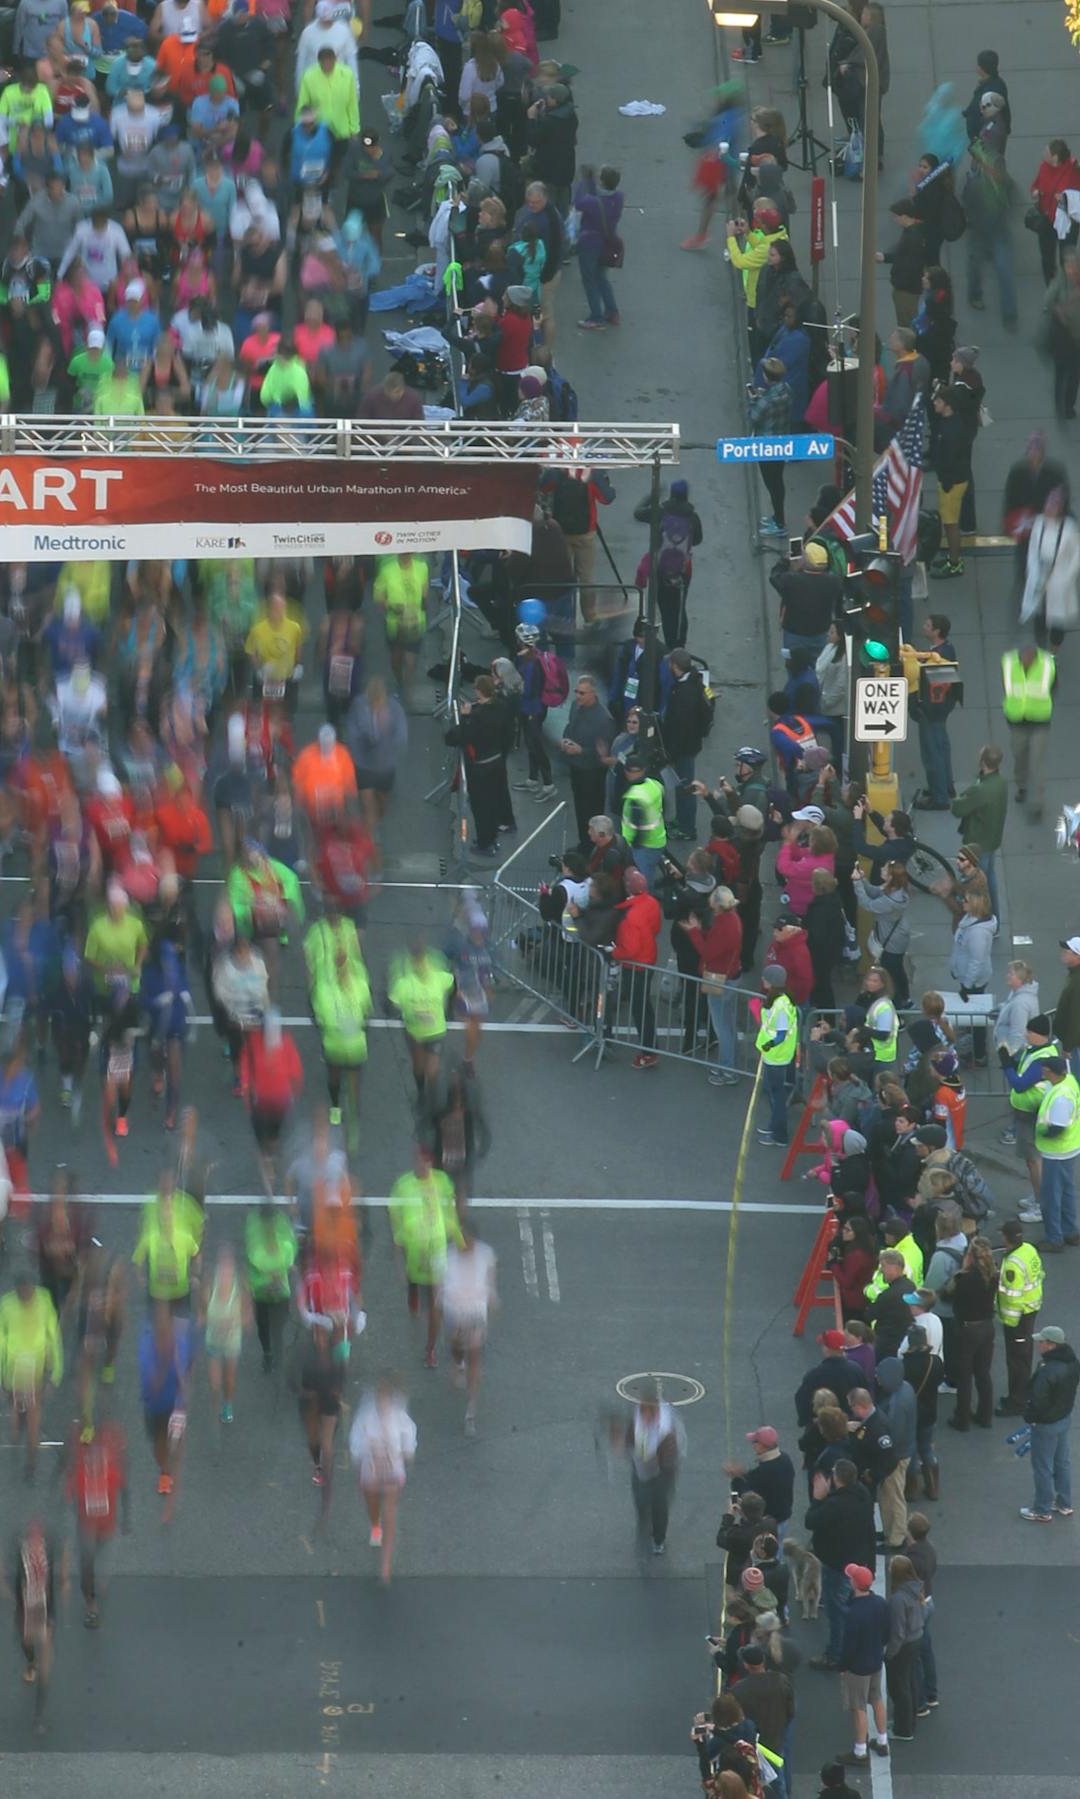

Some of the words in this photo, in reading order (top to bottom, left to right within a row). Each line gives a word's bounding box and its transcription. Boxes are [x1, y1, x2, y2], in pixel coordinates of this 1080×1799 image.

[723, 440, 793, 458] Portland
[807, 440, 829, 455] Av
[194, 483, 216, 493] The
[220, 484, 248, 493] Most
[251, 483, 303, 494] Beautiful
[307, 485, 343, 493] Urban
[346, 485, 401, 494] Marathon
[404, 485, 415, 493] in
[34, 536, 126, 550] Medtronic
[196, 538, 226, 548] KARE
[272, 534, 325, 543] TwinCities
[865, 683, 899, 697] ONE
[864, 701, 899, 714] WAY
